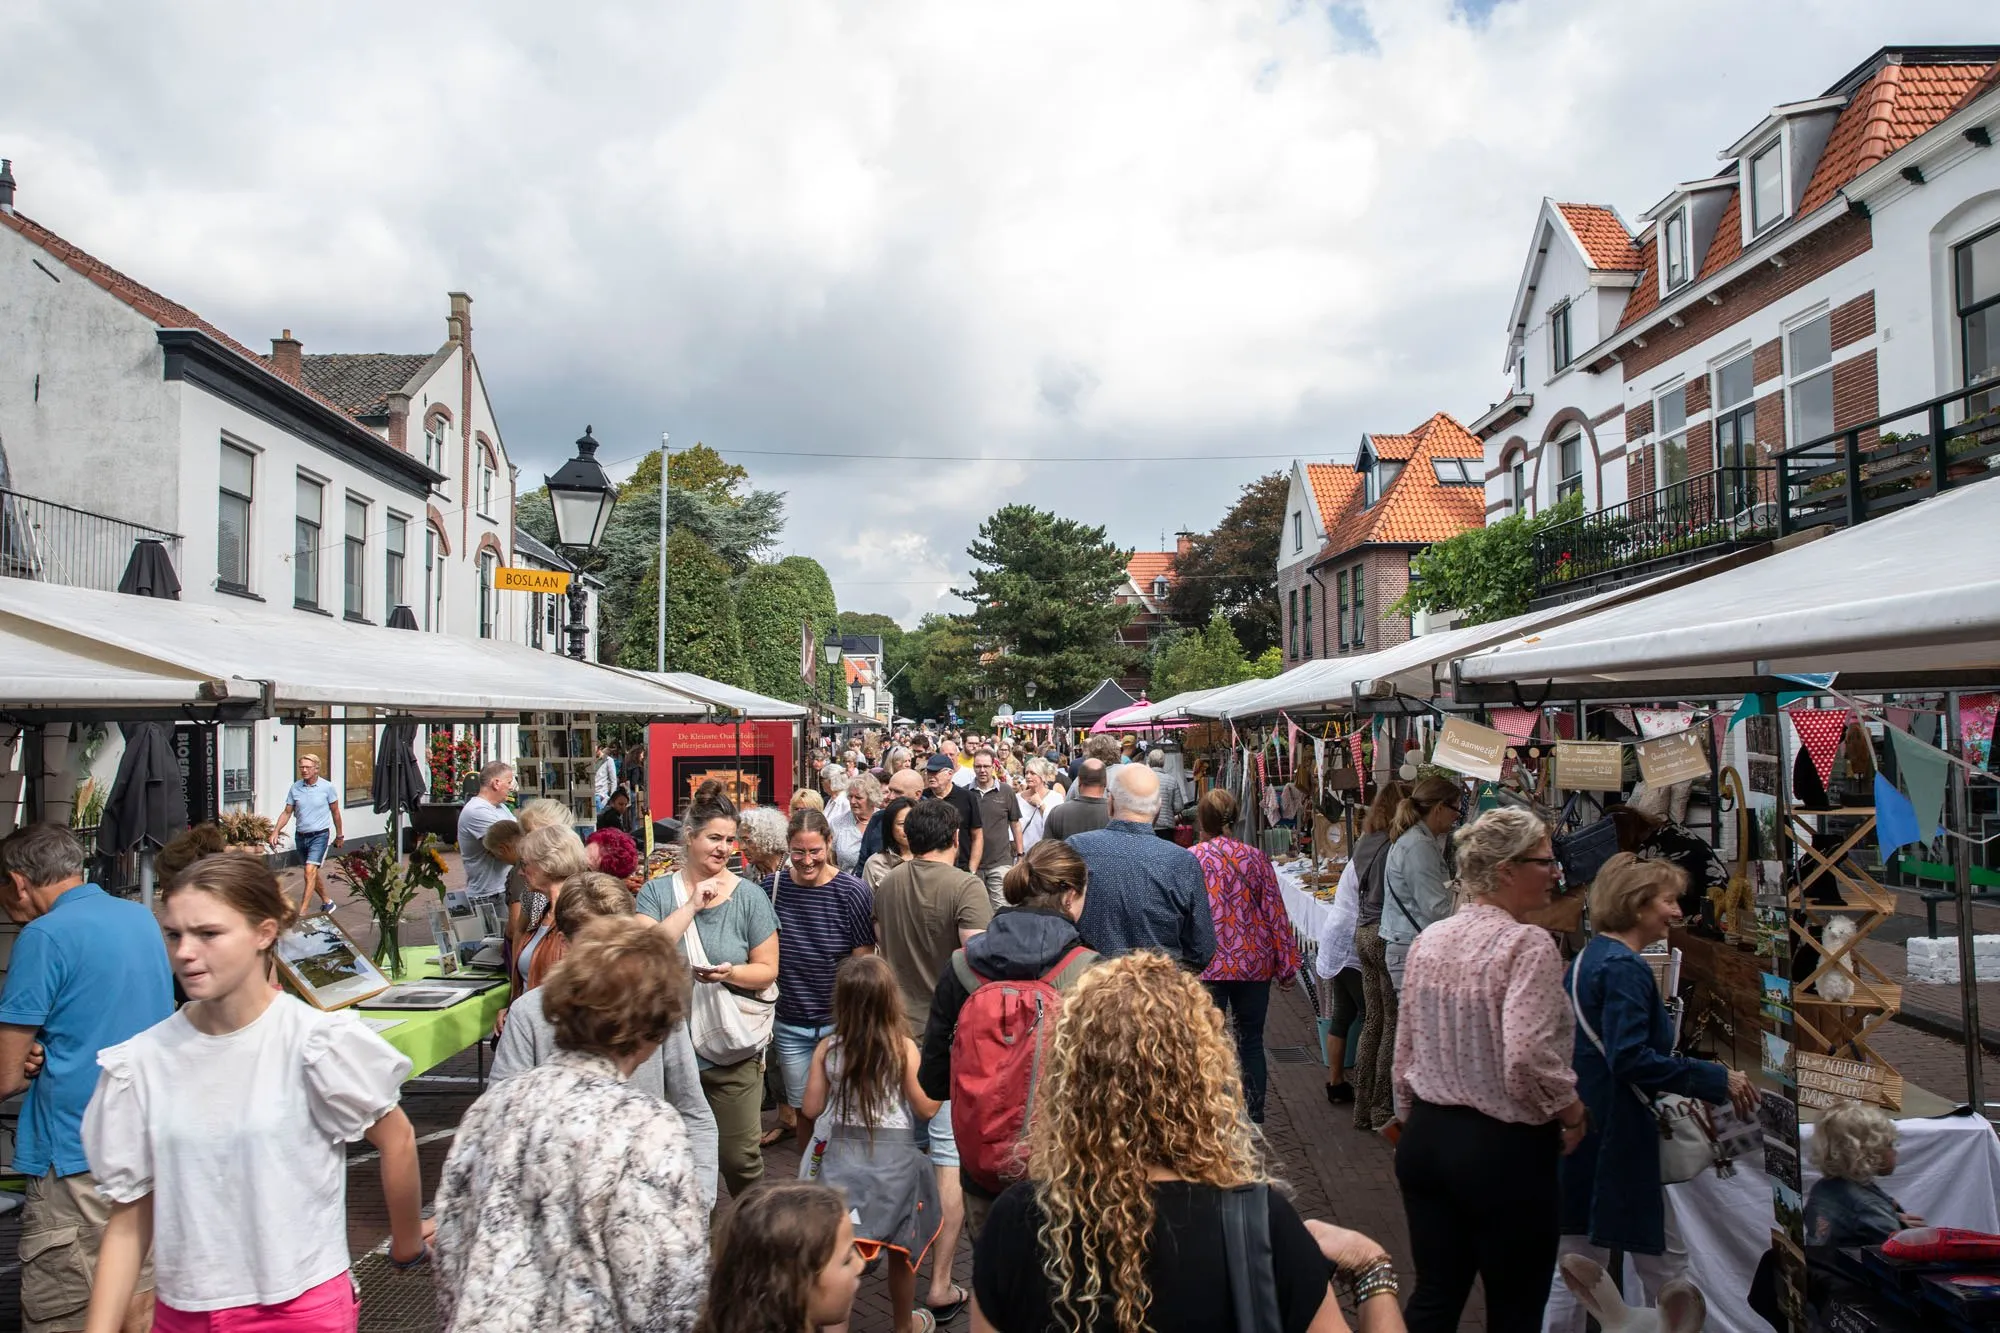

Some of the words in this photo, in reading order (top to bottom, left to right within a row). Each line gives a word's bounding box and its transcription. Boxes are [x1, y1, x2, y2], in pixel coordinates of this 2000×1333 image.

[506, 573, 559, 588] BOSLAAN
[1446, 730, 1460, 745] Pin
[1460, 740, 1500, 759] aanwezig!
[1824, 1060, 1876, 1081] ACHTEROM
[1800, 1087, 1835, 1107] DANS
